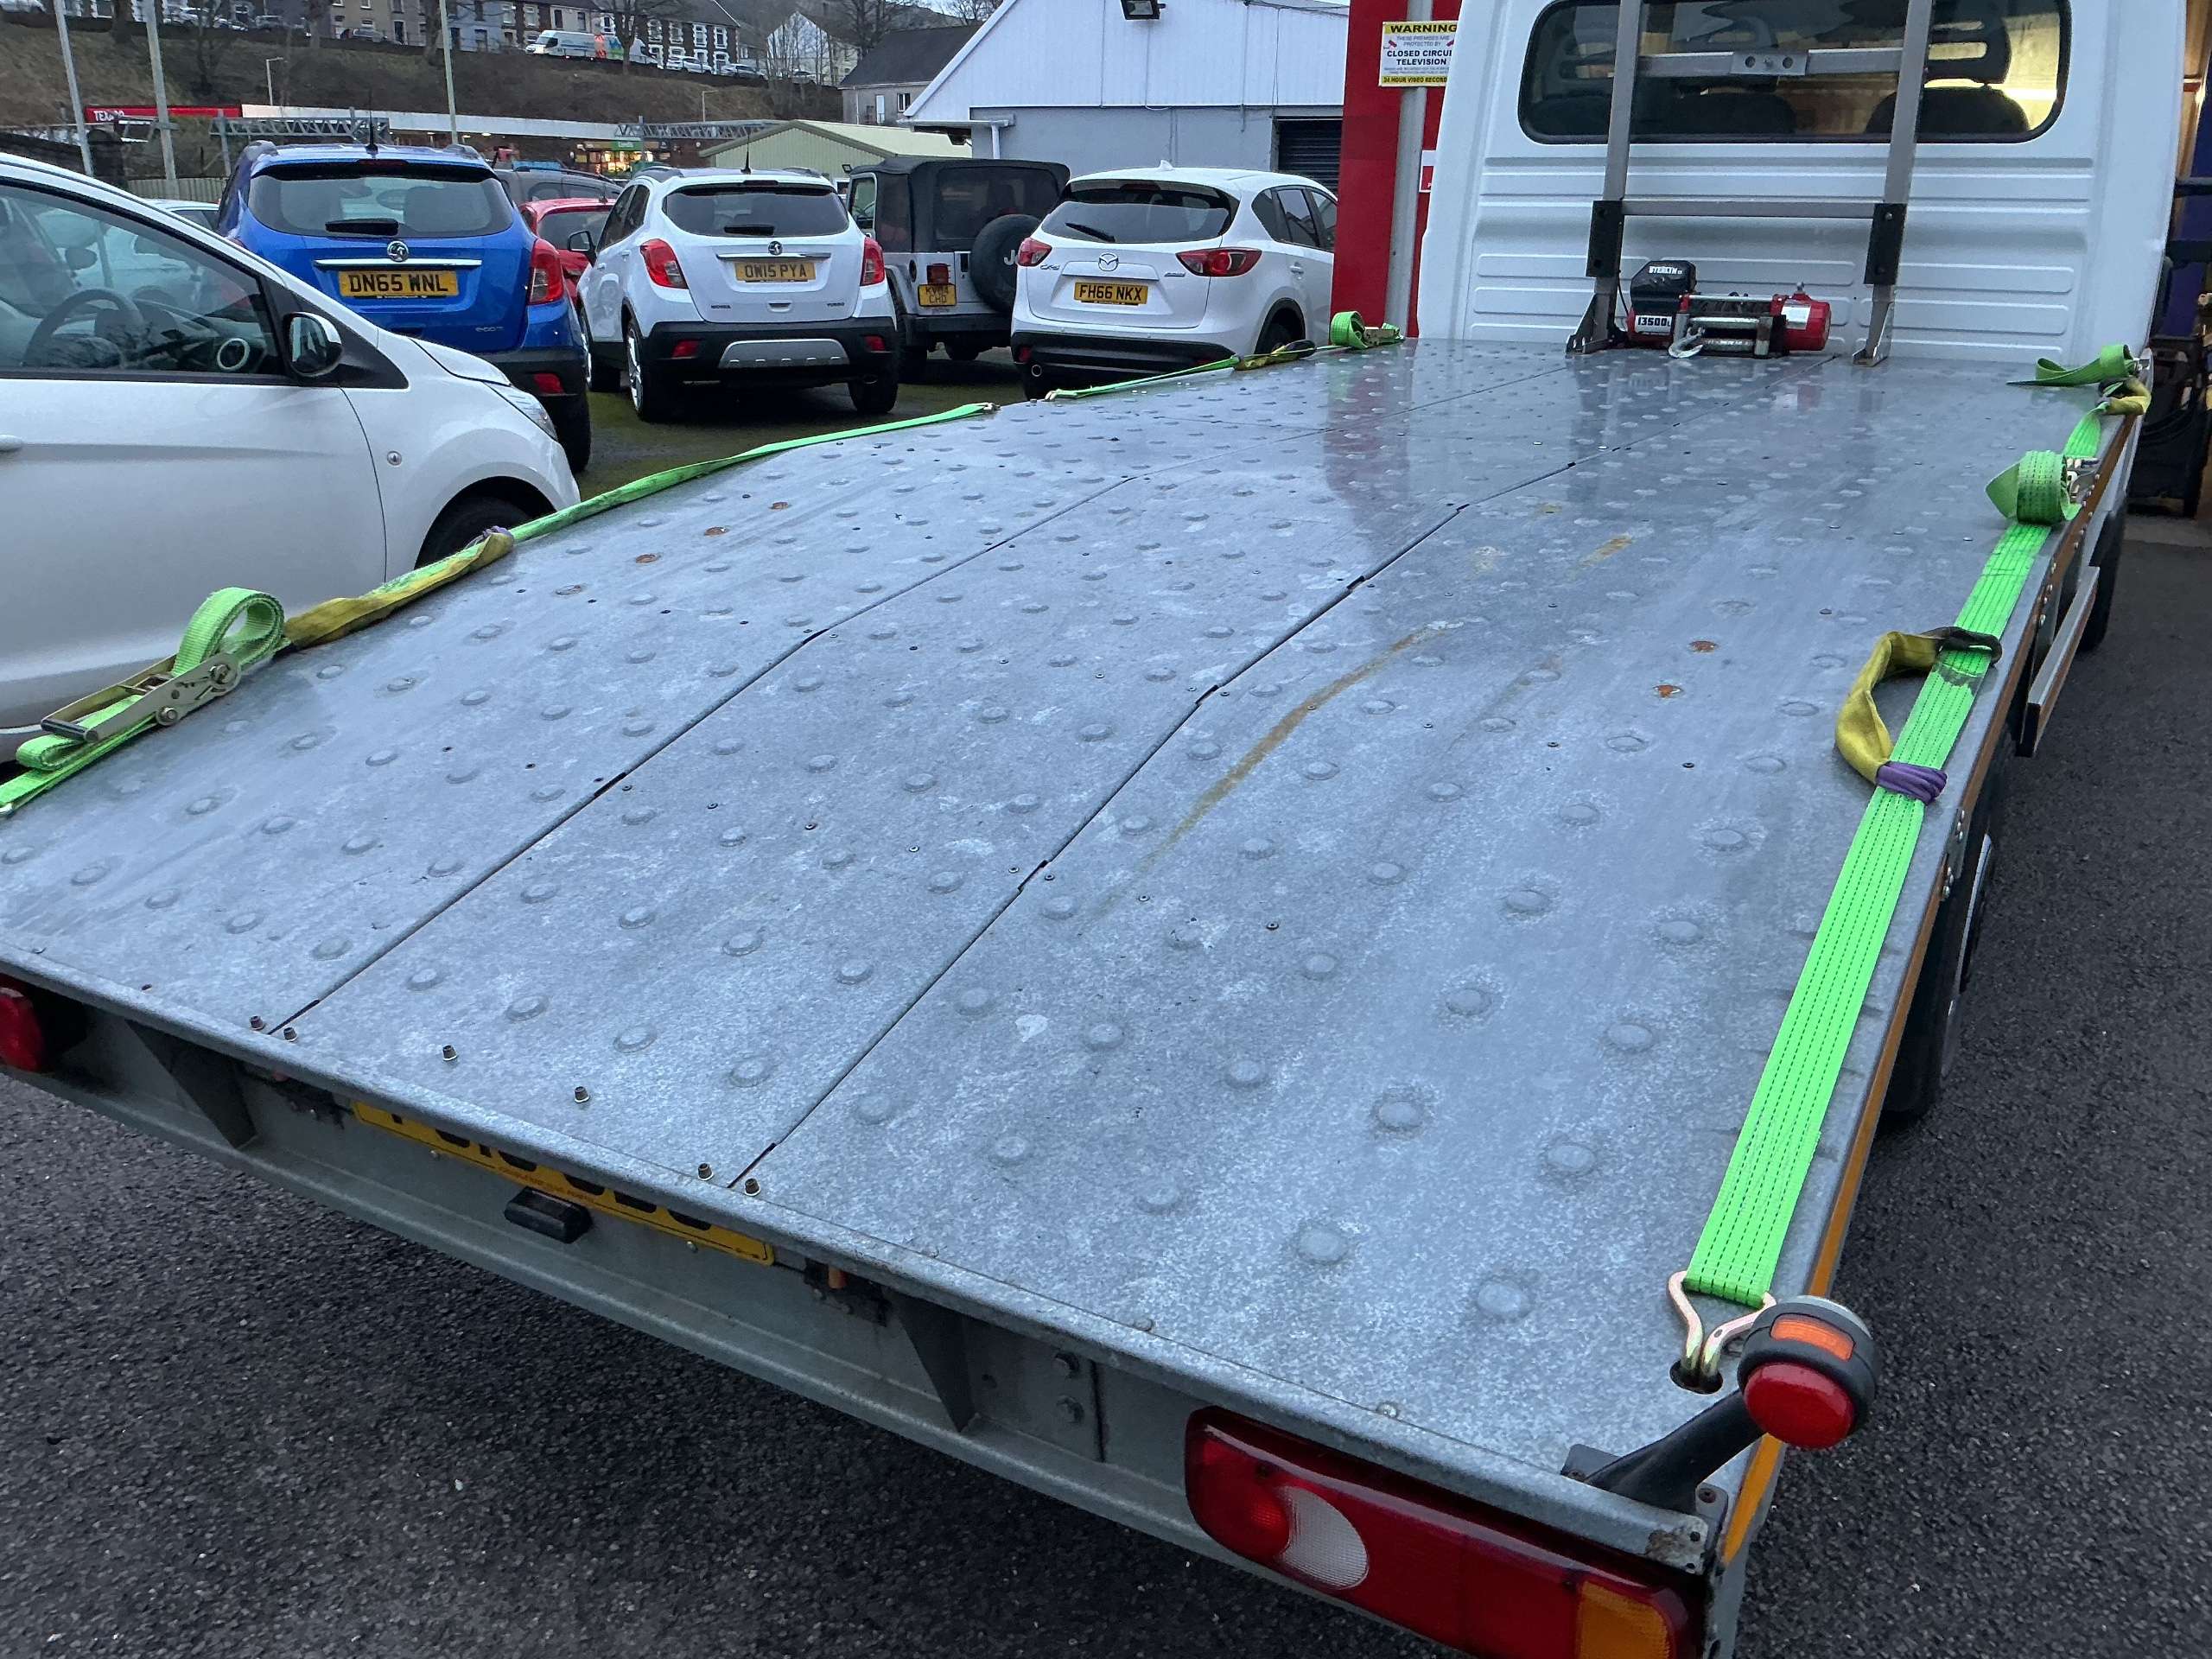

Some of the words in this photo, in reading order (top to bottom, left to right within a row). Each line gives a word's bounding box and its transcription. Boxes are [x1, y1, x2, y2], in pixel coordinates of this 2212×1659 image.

[1390, 24, 1457, 33] WARNING
[779, 264, 807, 277] PYA
[348, 274, 404, 293] DN65
[408, 274, 448, 292] WNL
[1079, 284, 1112, 299] FH66
[1116, 286, 1142, 302] NKX
